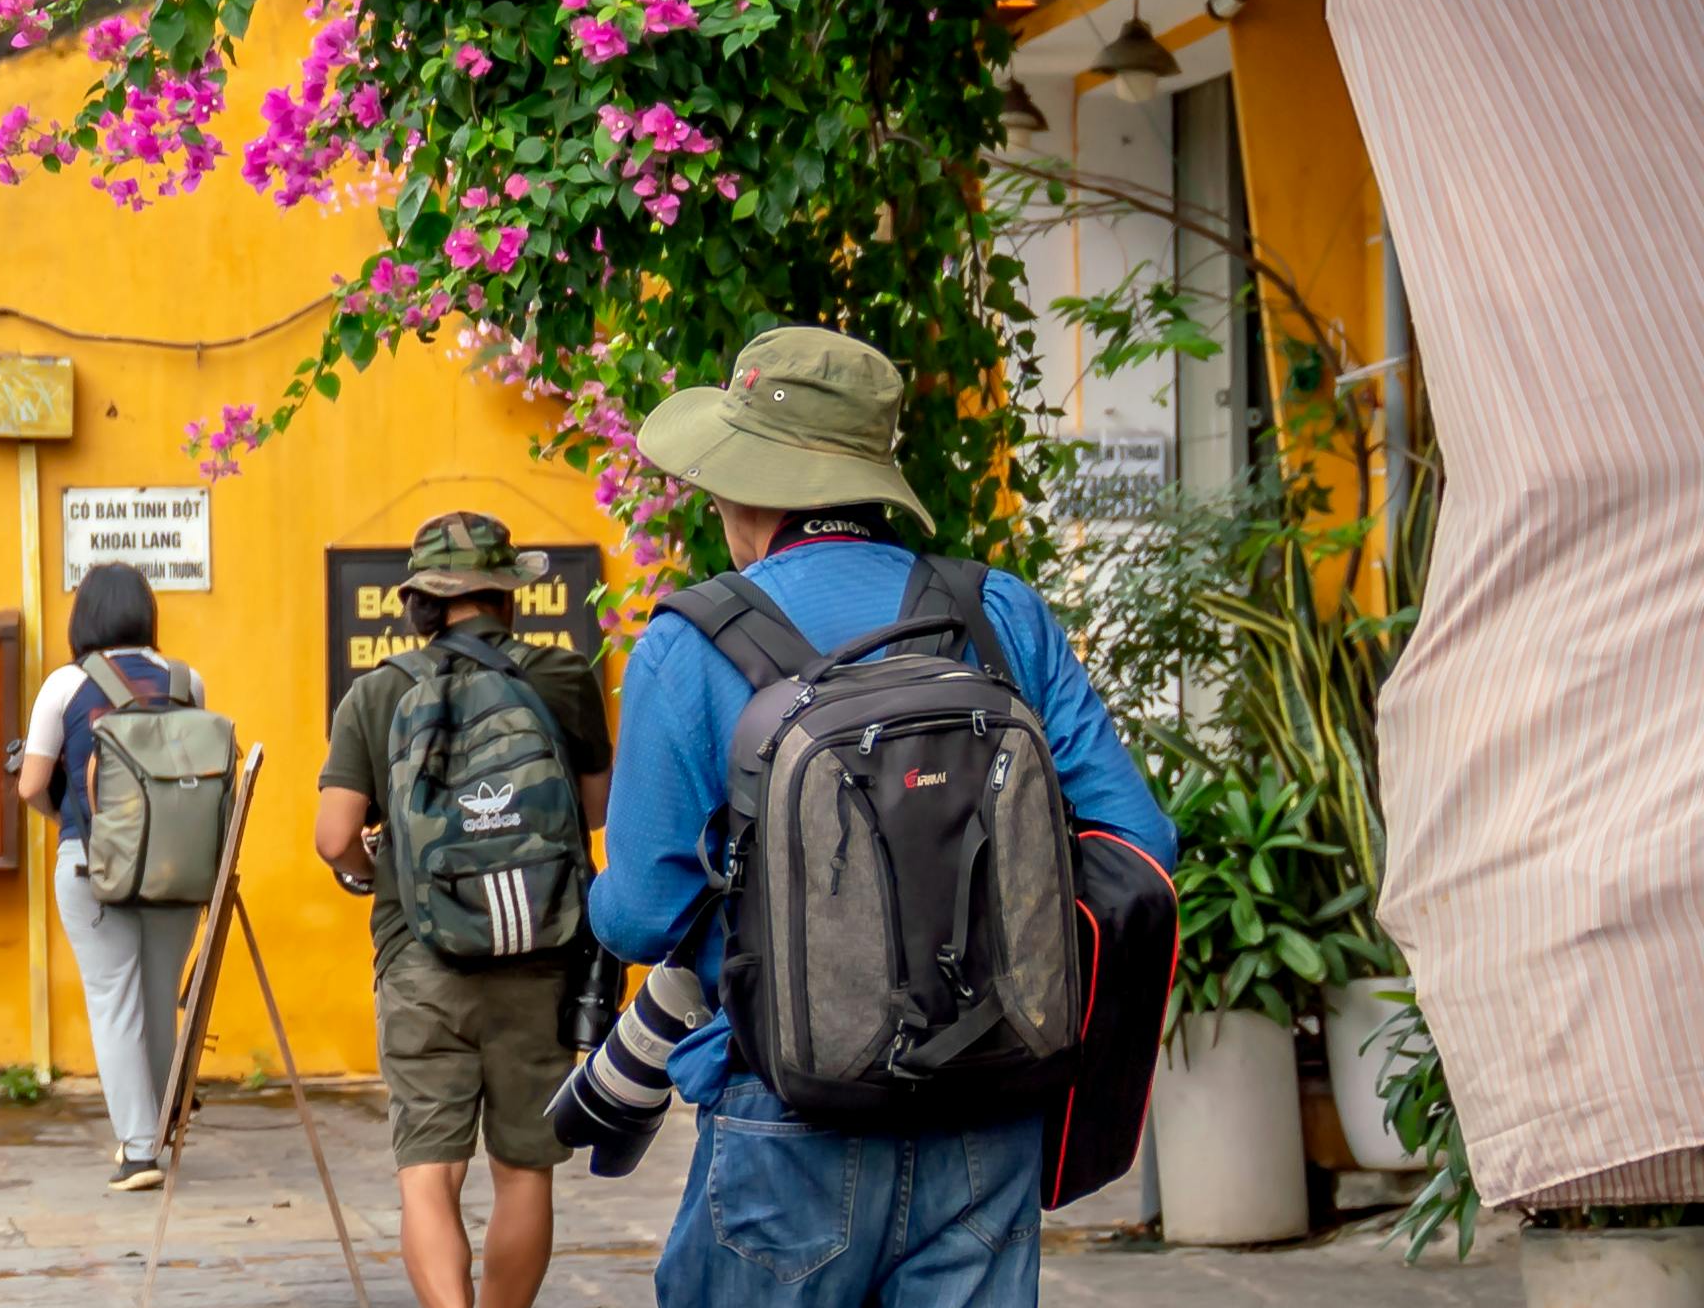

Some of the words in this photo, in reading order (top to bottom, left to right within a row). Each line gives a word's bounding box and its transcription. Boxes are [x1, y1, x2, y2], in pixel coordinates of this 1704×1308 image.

[132, 500, 167, 518] TINH
[803, 519, 871, 537] Canon
[90, 532, 137, 550] KHOAI
[141, 532, 181, 549] LANG
[462, 812, 521, 832] adidas
